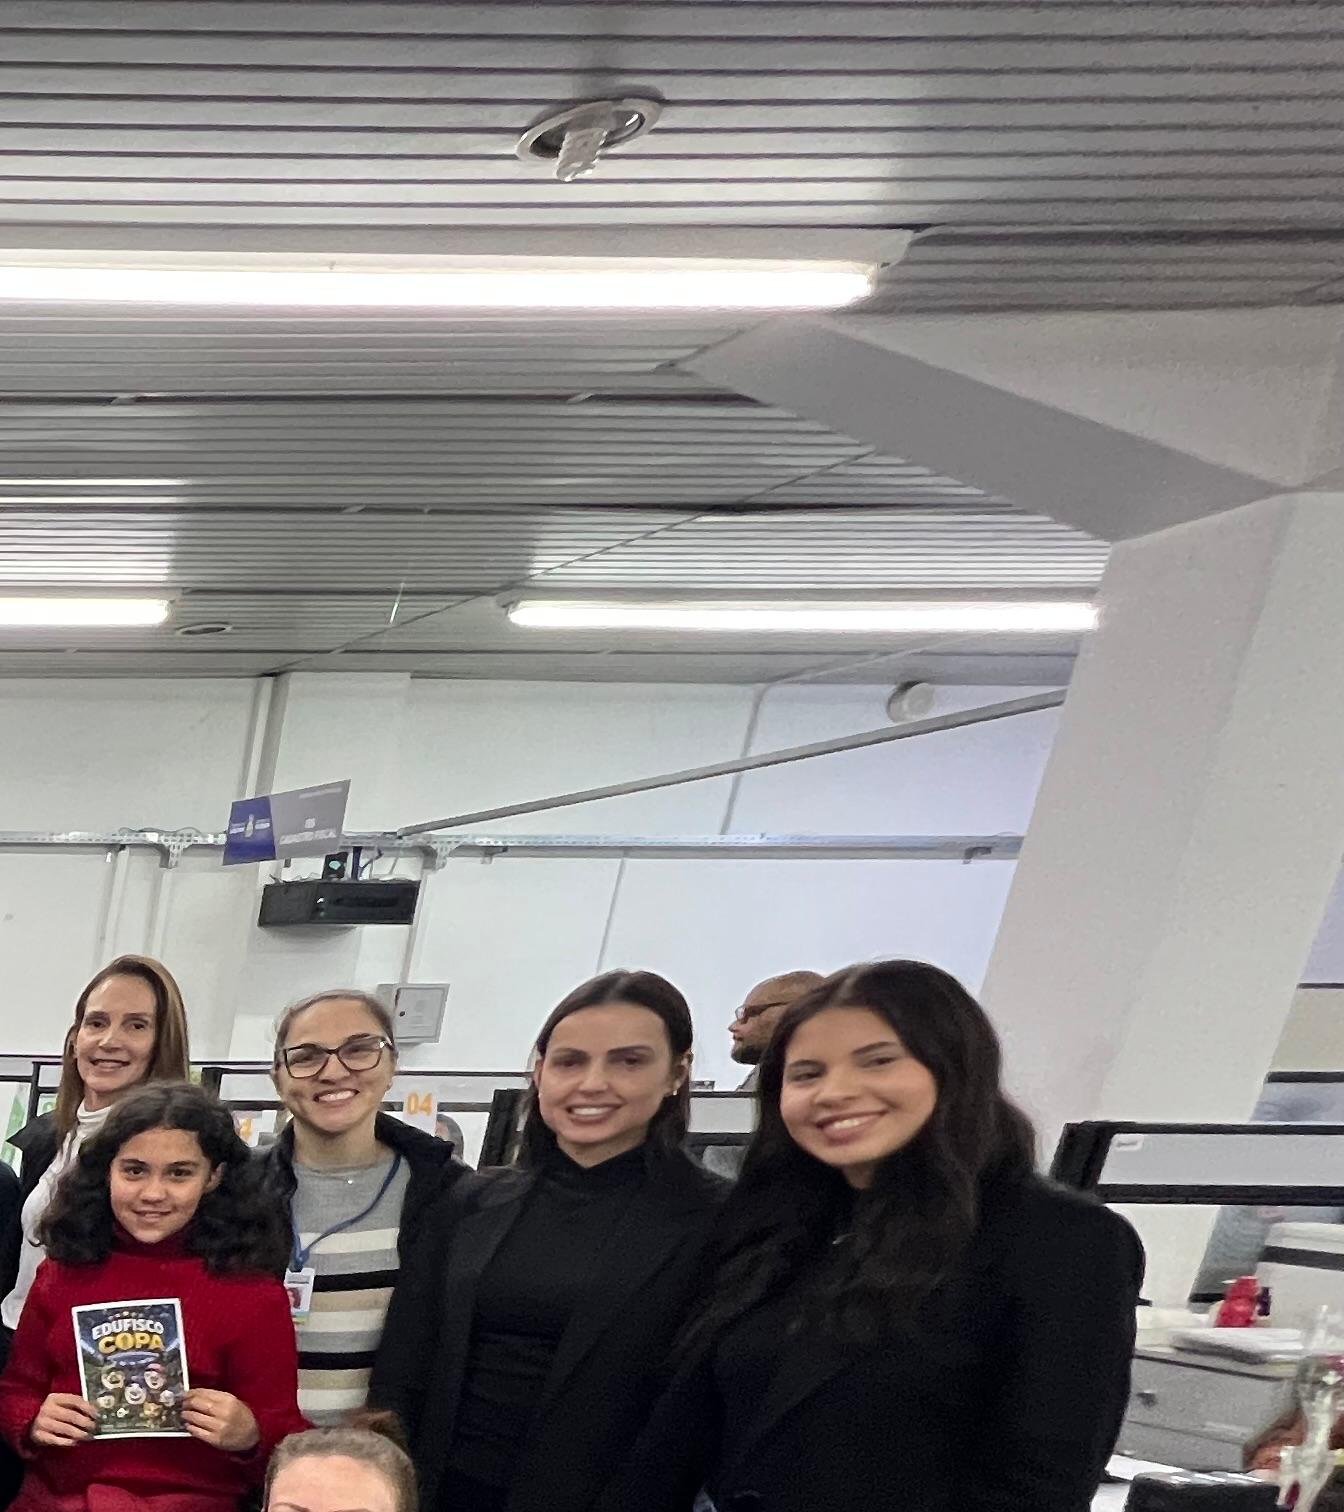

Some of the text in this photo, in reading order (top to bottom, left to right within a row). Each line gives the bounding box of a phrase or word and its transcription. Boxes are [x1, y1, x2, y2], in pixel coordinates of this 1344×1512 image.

[406, 1091, 433, 1117] 04
[92, 1318, 164, 1340] EDUFISCO
[98, 1332, 165, 1354] COPA
